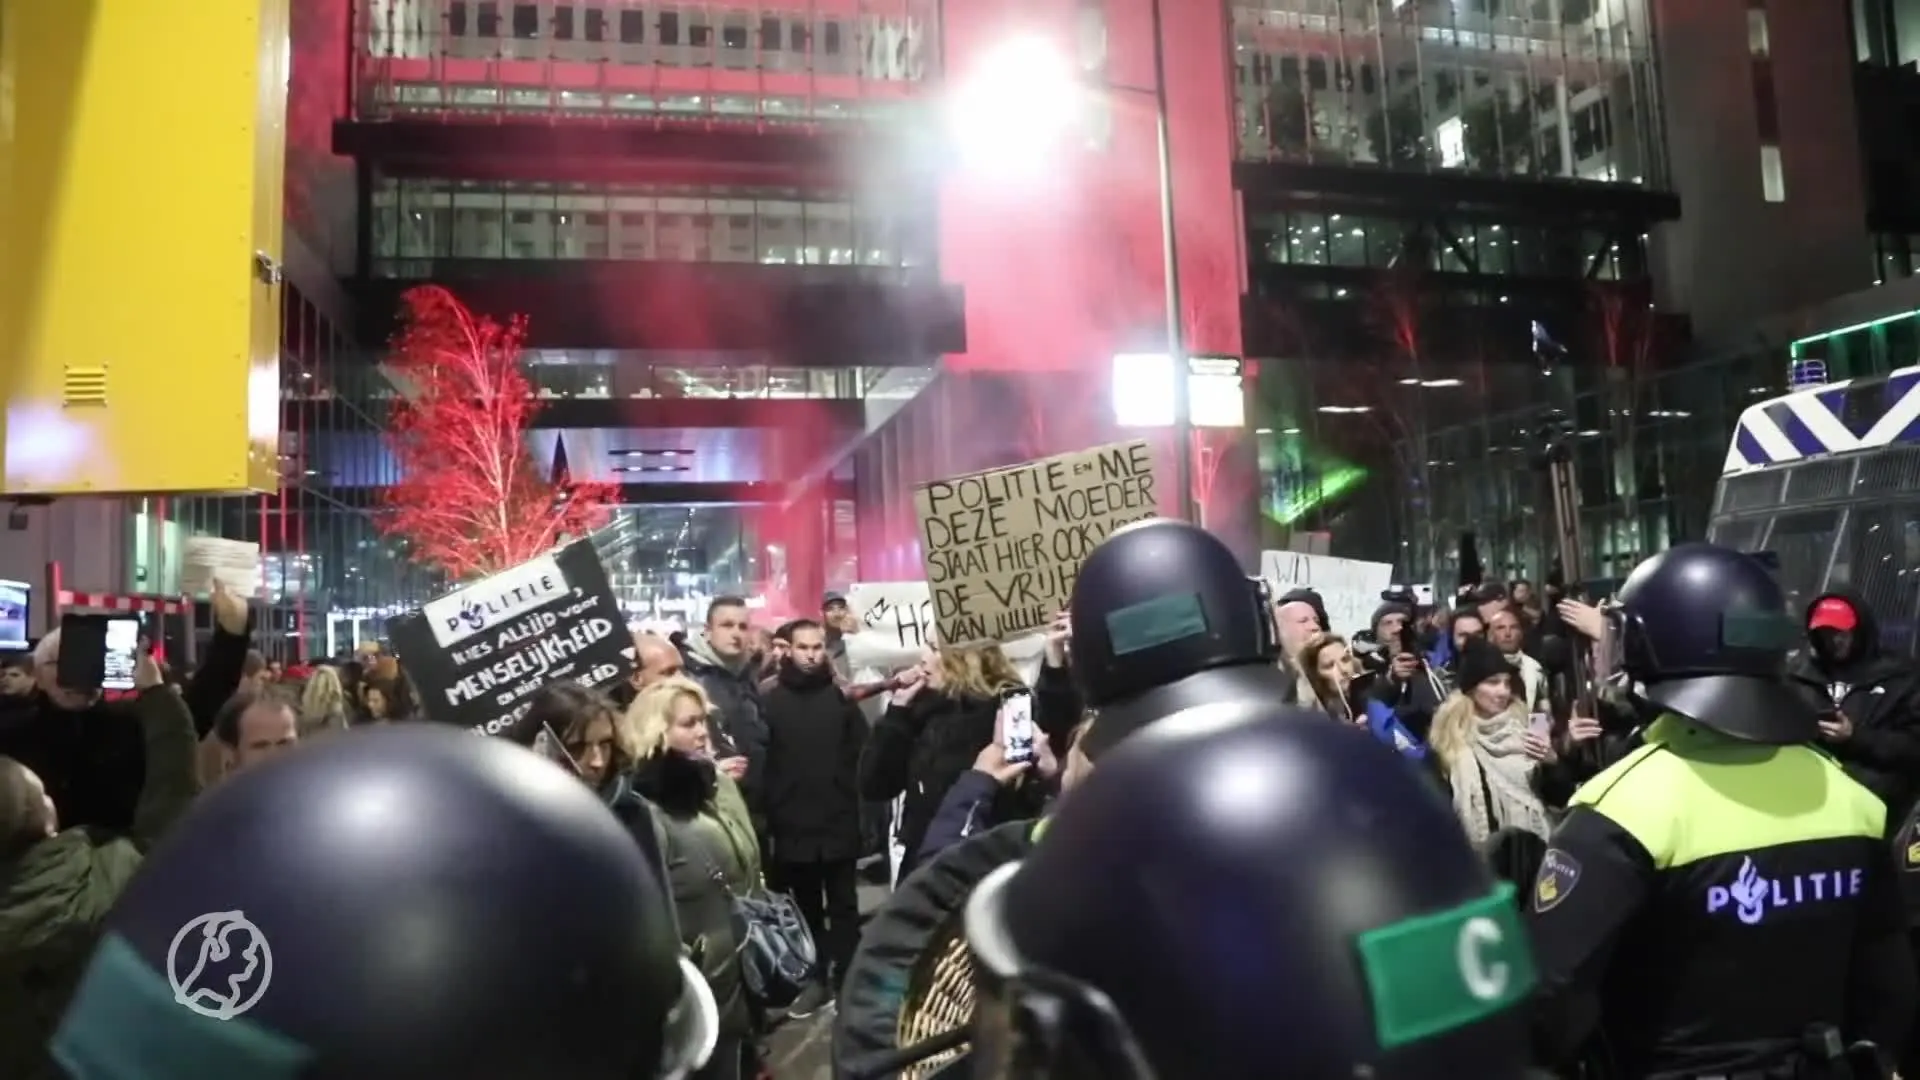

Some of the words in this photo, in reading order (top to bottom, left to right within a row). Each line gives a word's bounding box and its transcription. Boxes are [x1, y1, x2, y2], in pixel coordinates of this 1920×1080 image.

[925, 503, 1009, 549] DEZE
[1033, 474, 1157, 529] MOEDER
[928, 461, 1067, 514] POLITIE
[1098, 443, 1150, 481] ME
[927, 542, 990, 583] STAAT
[996, 533, 1051, 573] HIER
[1053, 522, 1095, 562] OOK
[935, 584, 972, 619] DE
[984, 562, 1079, 608] VRIJH
[936, 614, 987, 645] VAN
[993, 603, 1049, 640] JULLIE
[1457, 916, 1509, 1000] C
